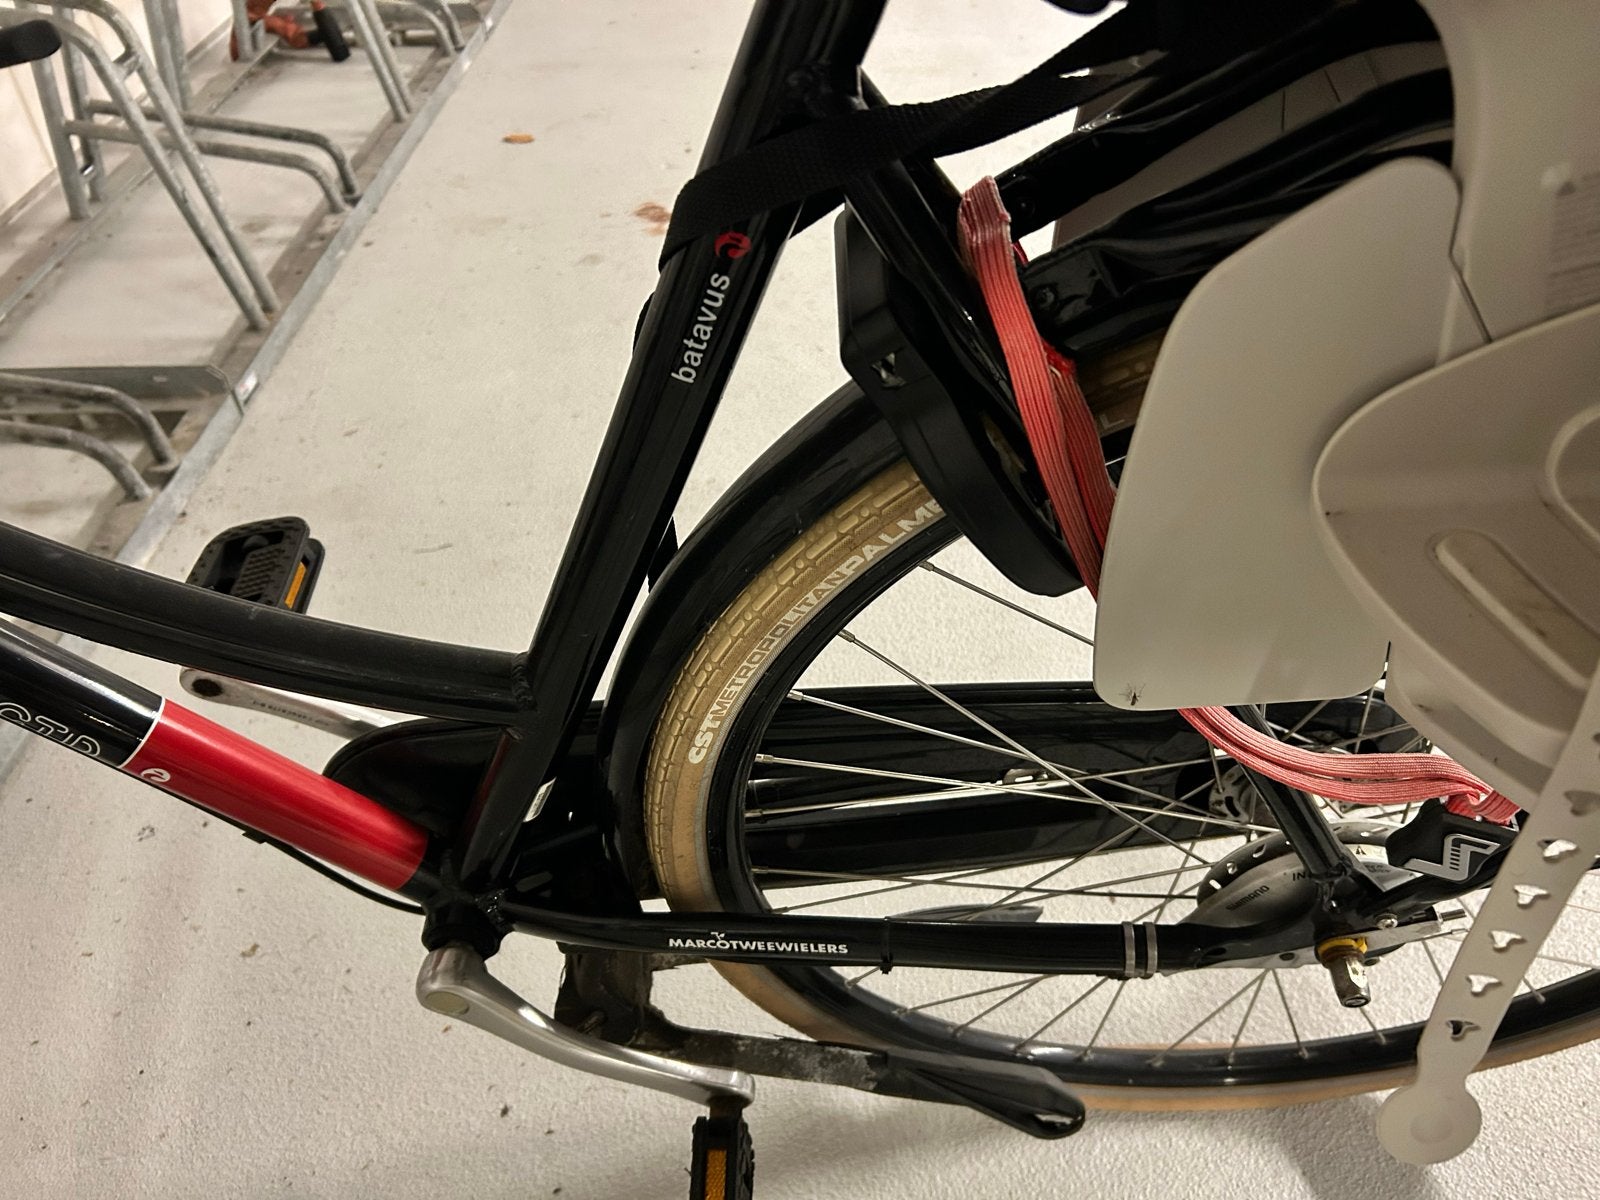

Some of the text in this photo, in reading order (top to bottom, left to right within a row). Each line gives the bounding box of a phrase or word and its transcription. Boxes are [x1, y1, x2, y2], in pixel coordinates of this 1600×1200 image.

[671, 273, 730, 384] batavus
[688, 714, 721, 764] CST
[708, 569, 850, 718] METROPOLITAN
[669, 937, 849, 954] MARCOTWEEWIELERS
